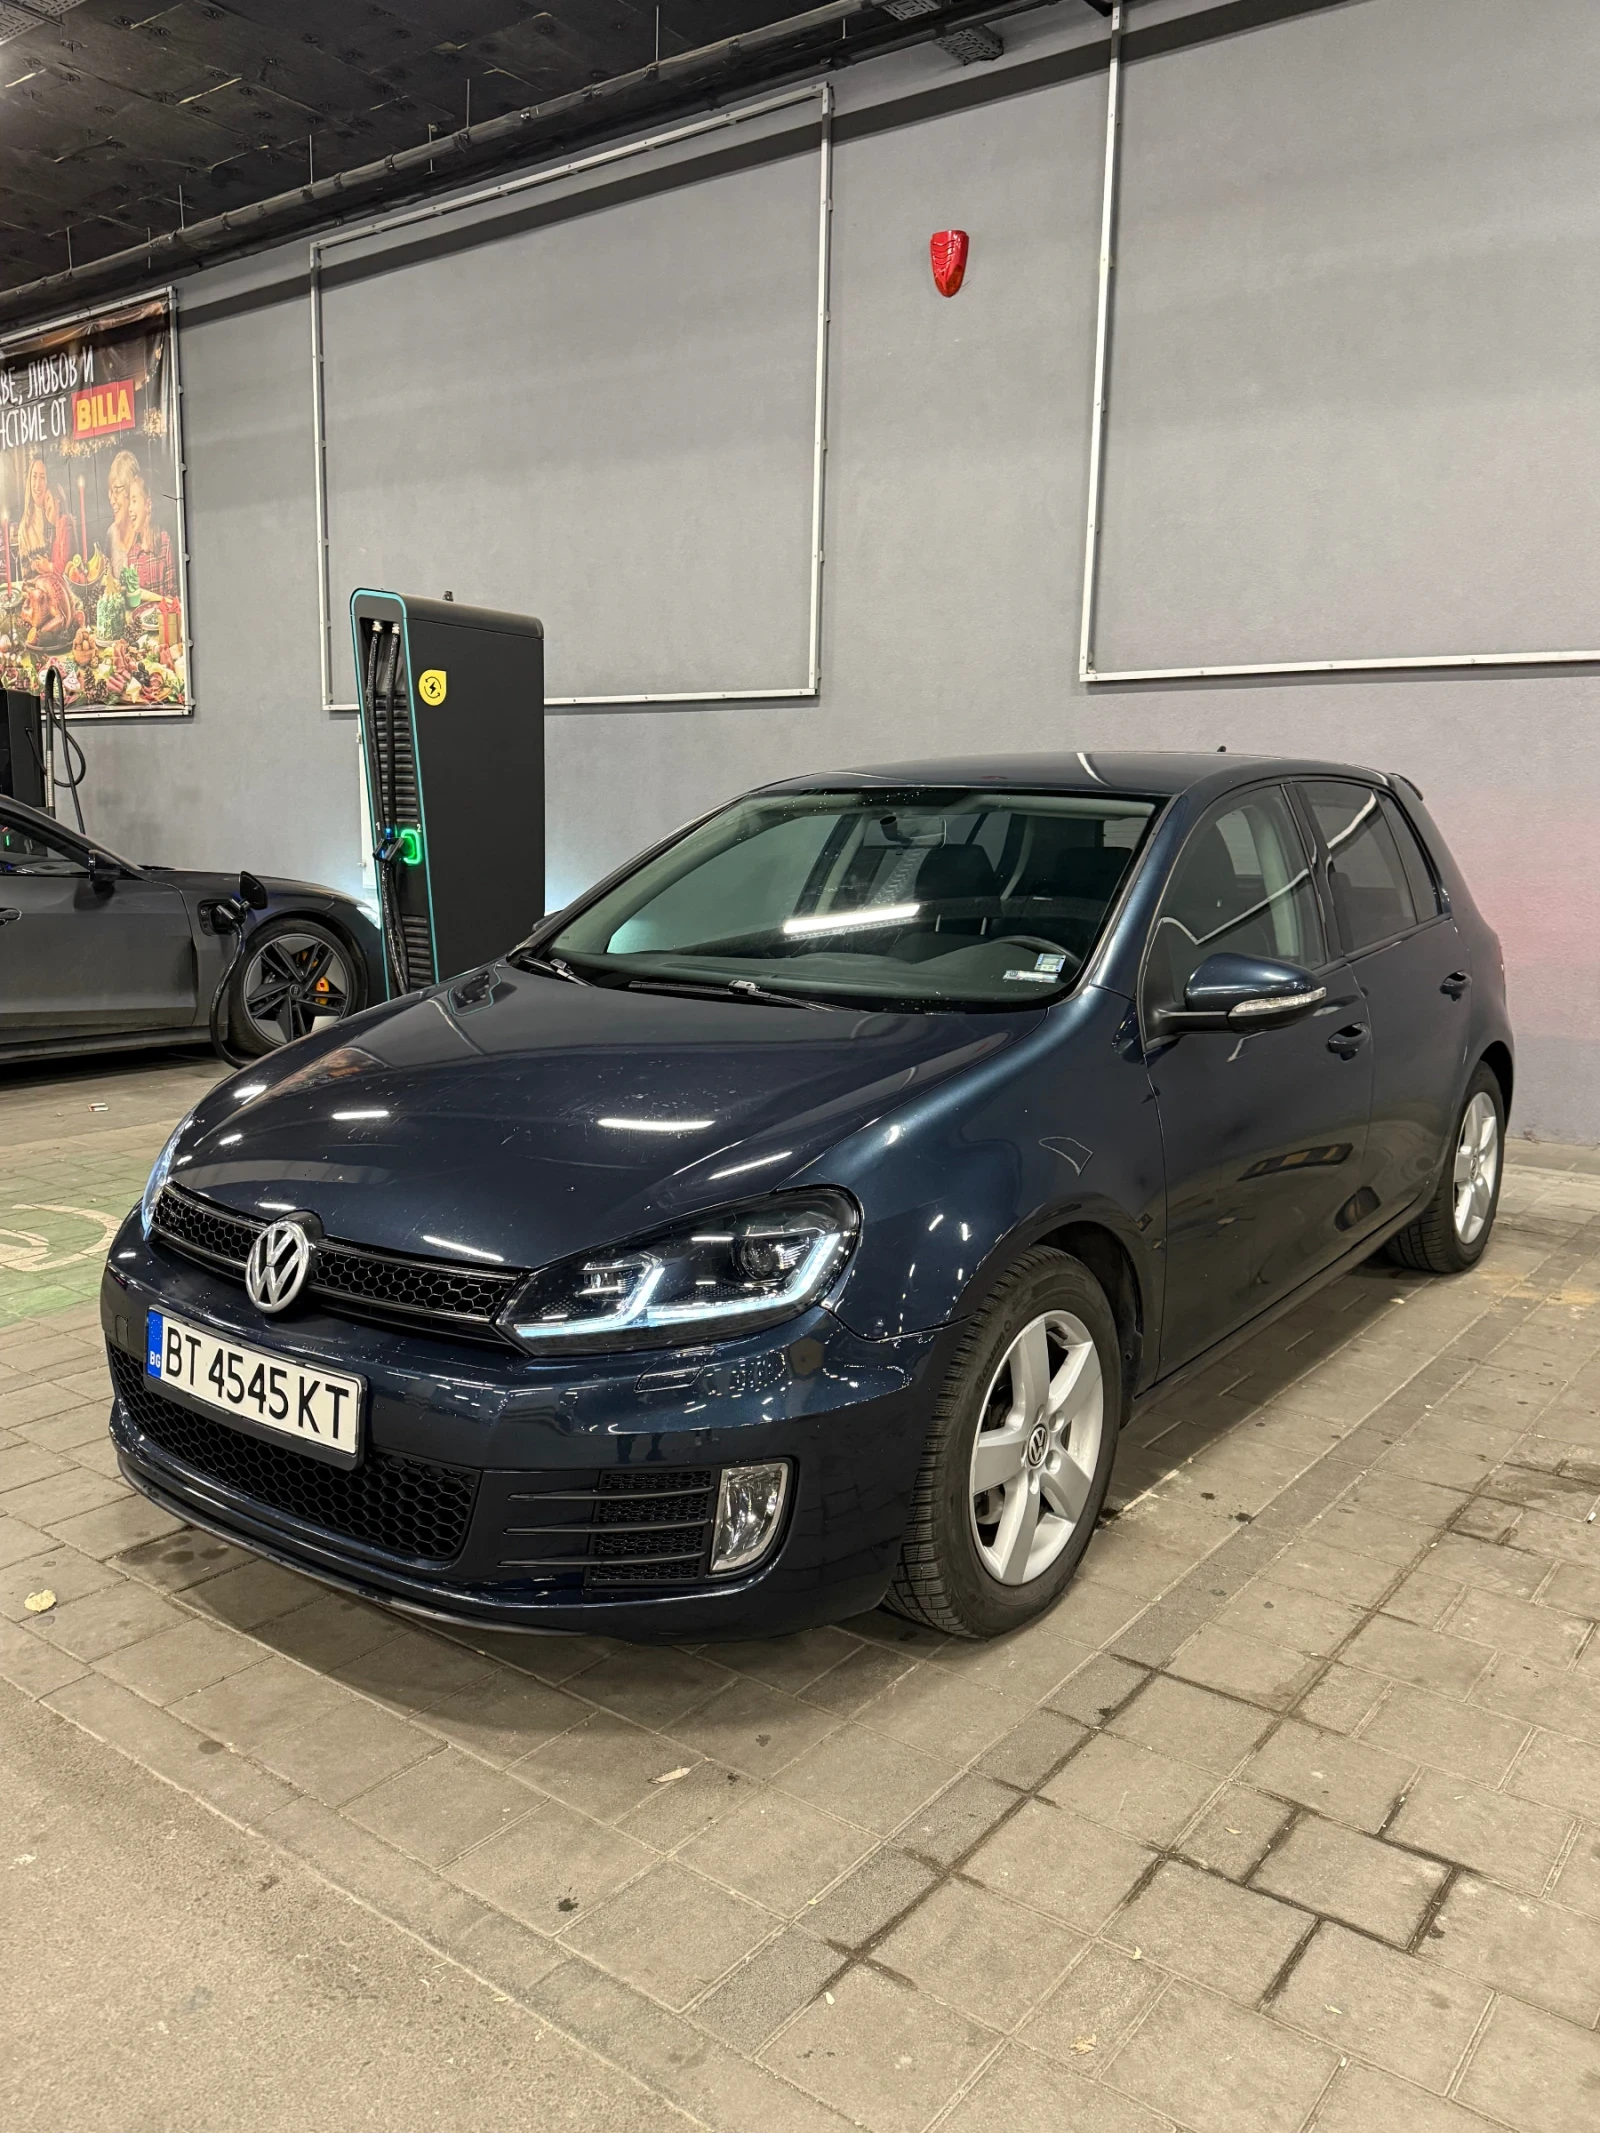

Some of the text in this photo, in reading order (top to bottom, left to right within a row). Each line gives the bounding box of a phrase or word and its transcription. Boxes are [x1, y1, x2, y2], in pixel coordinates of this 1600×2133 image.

[27, 352, 78, 399] ЛЮБОВ
[82, 345, 94, 382] И
[51, 397, 67, 437] ОТ
[77, 389, 131, 432] BILLA
[149, 1350, 161, 1369] BG
[165, 1326, 349, 1440] BT 4545 KT
